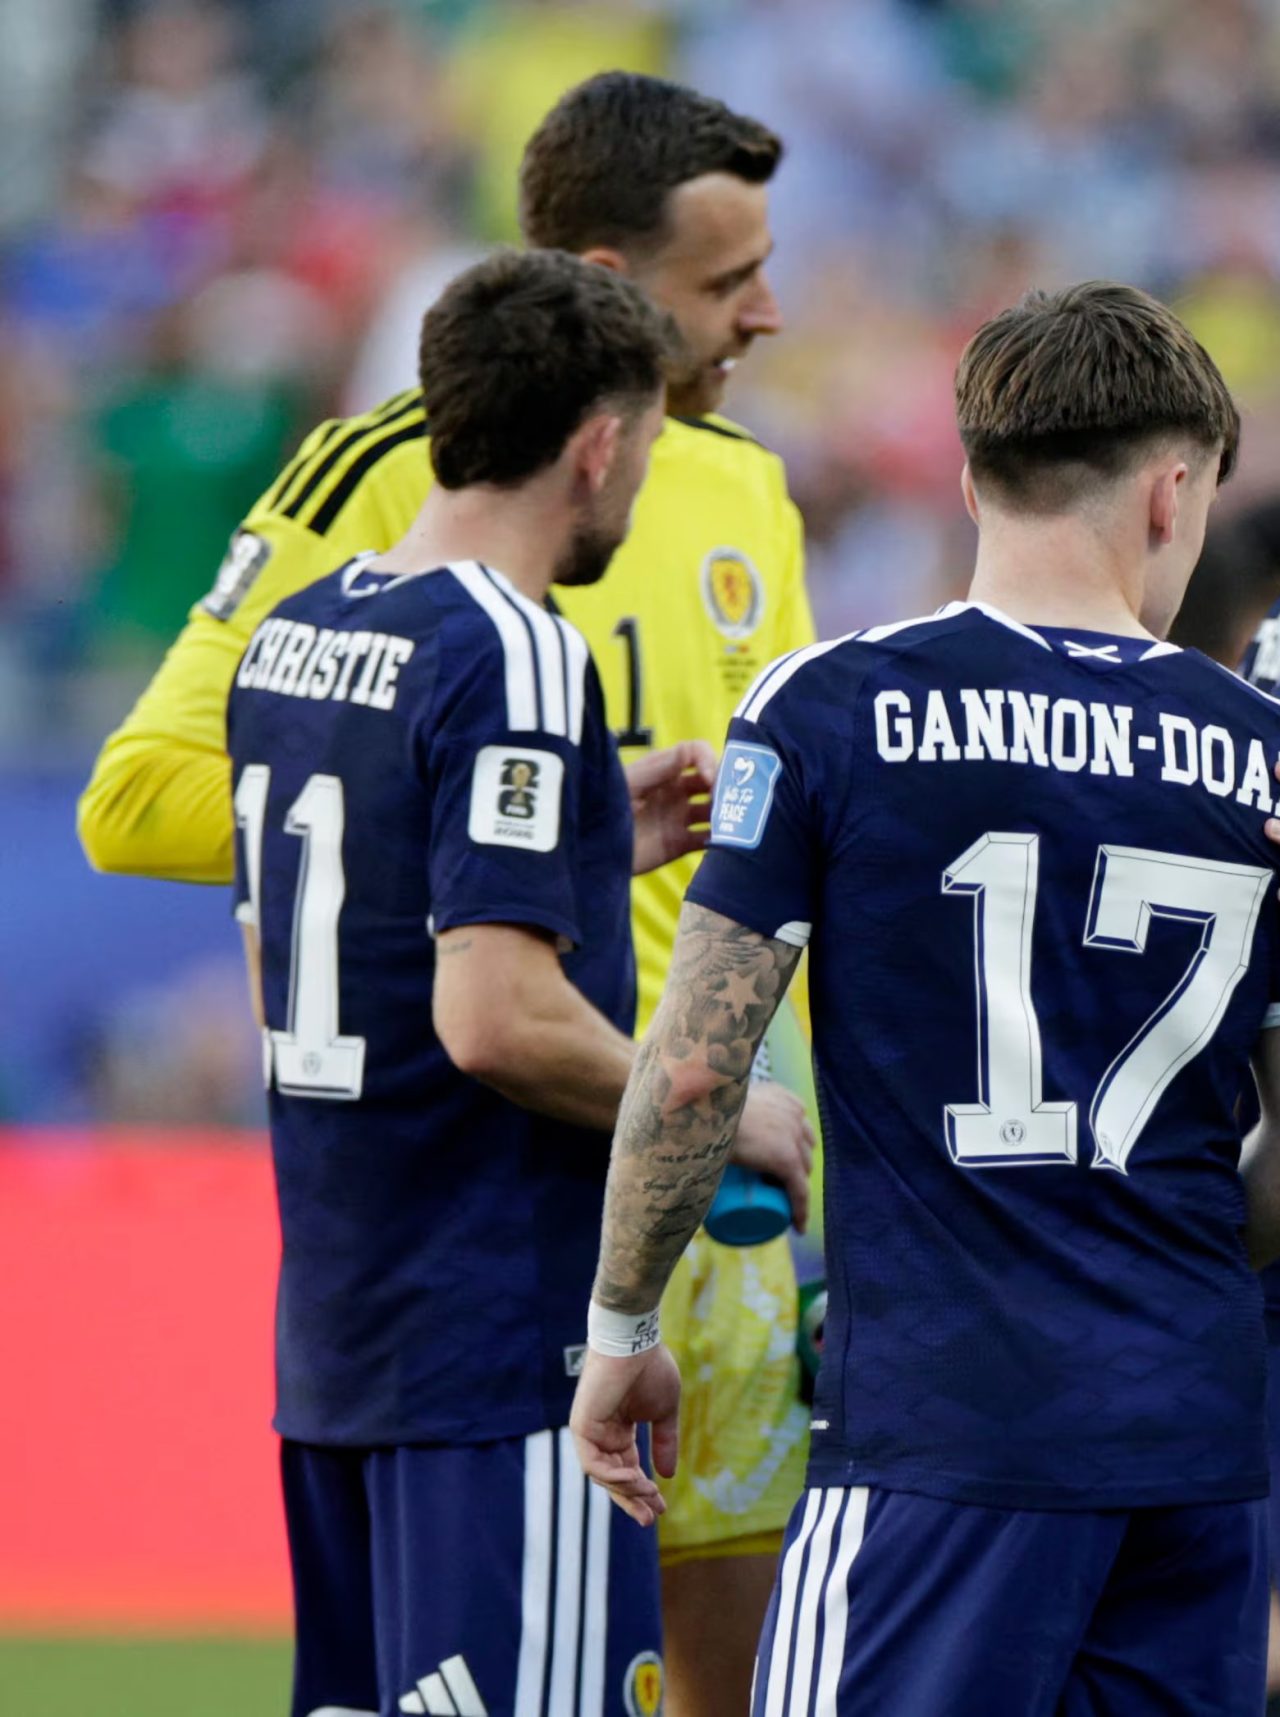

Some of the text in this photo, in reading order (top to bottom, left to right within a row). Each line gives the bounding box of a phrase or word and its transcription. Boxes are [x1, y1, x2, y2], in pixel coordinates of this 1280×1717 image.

[237, 617, 414, 710] CHRISTIE
[612, 617, 654, 747] 1
[234, 764, 366, 1100] 11
[942, 831, 1273, 1176] 17
